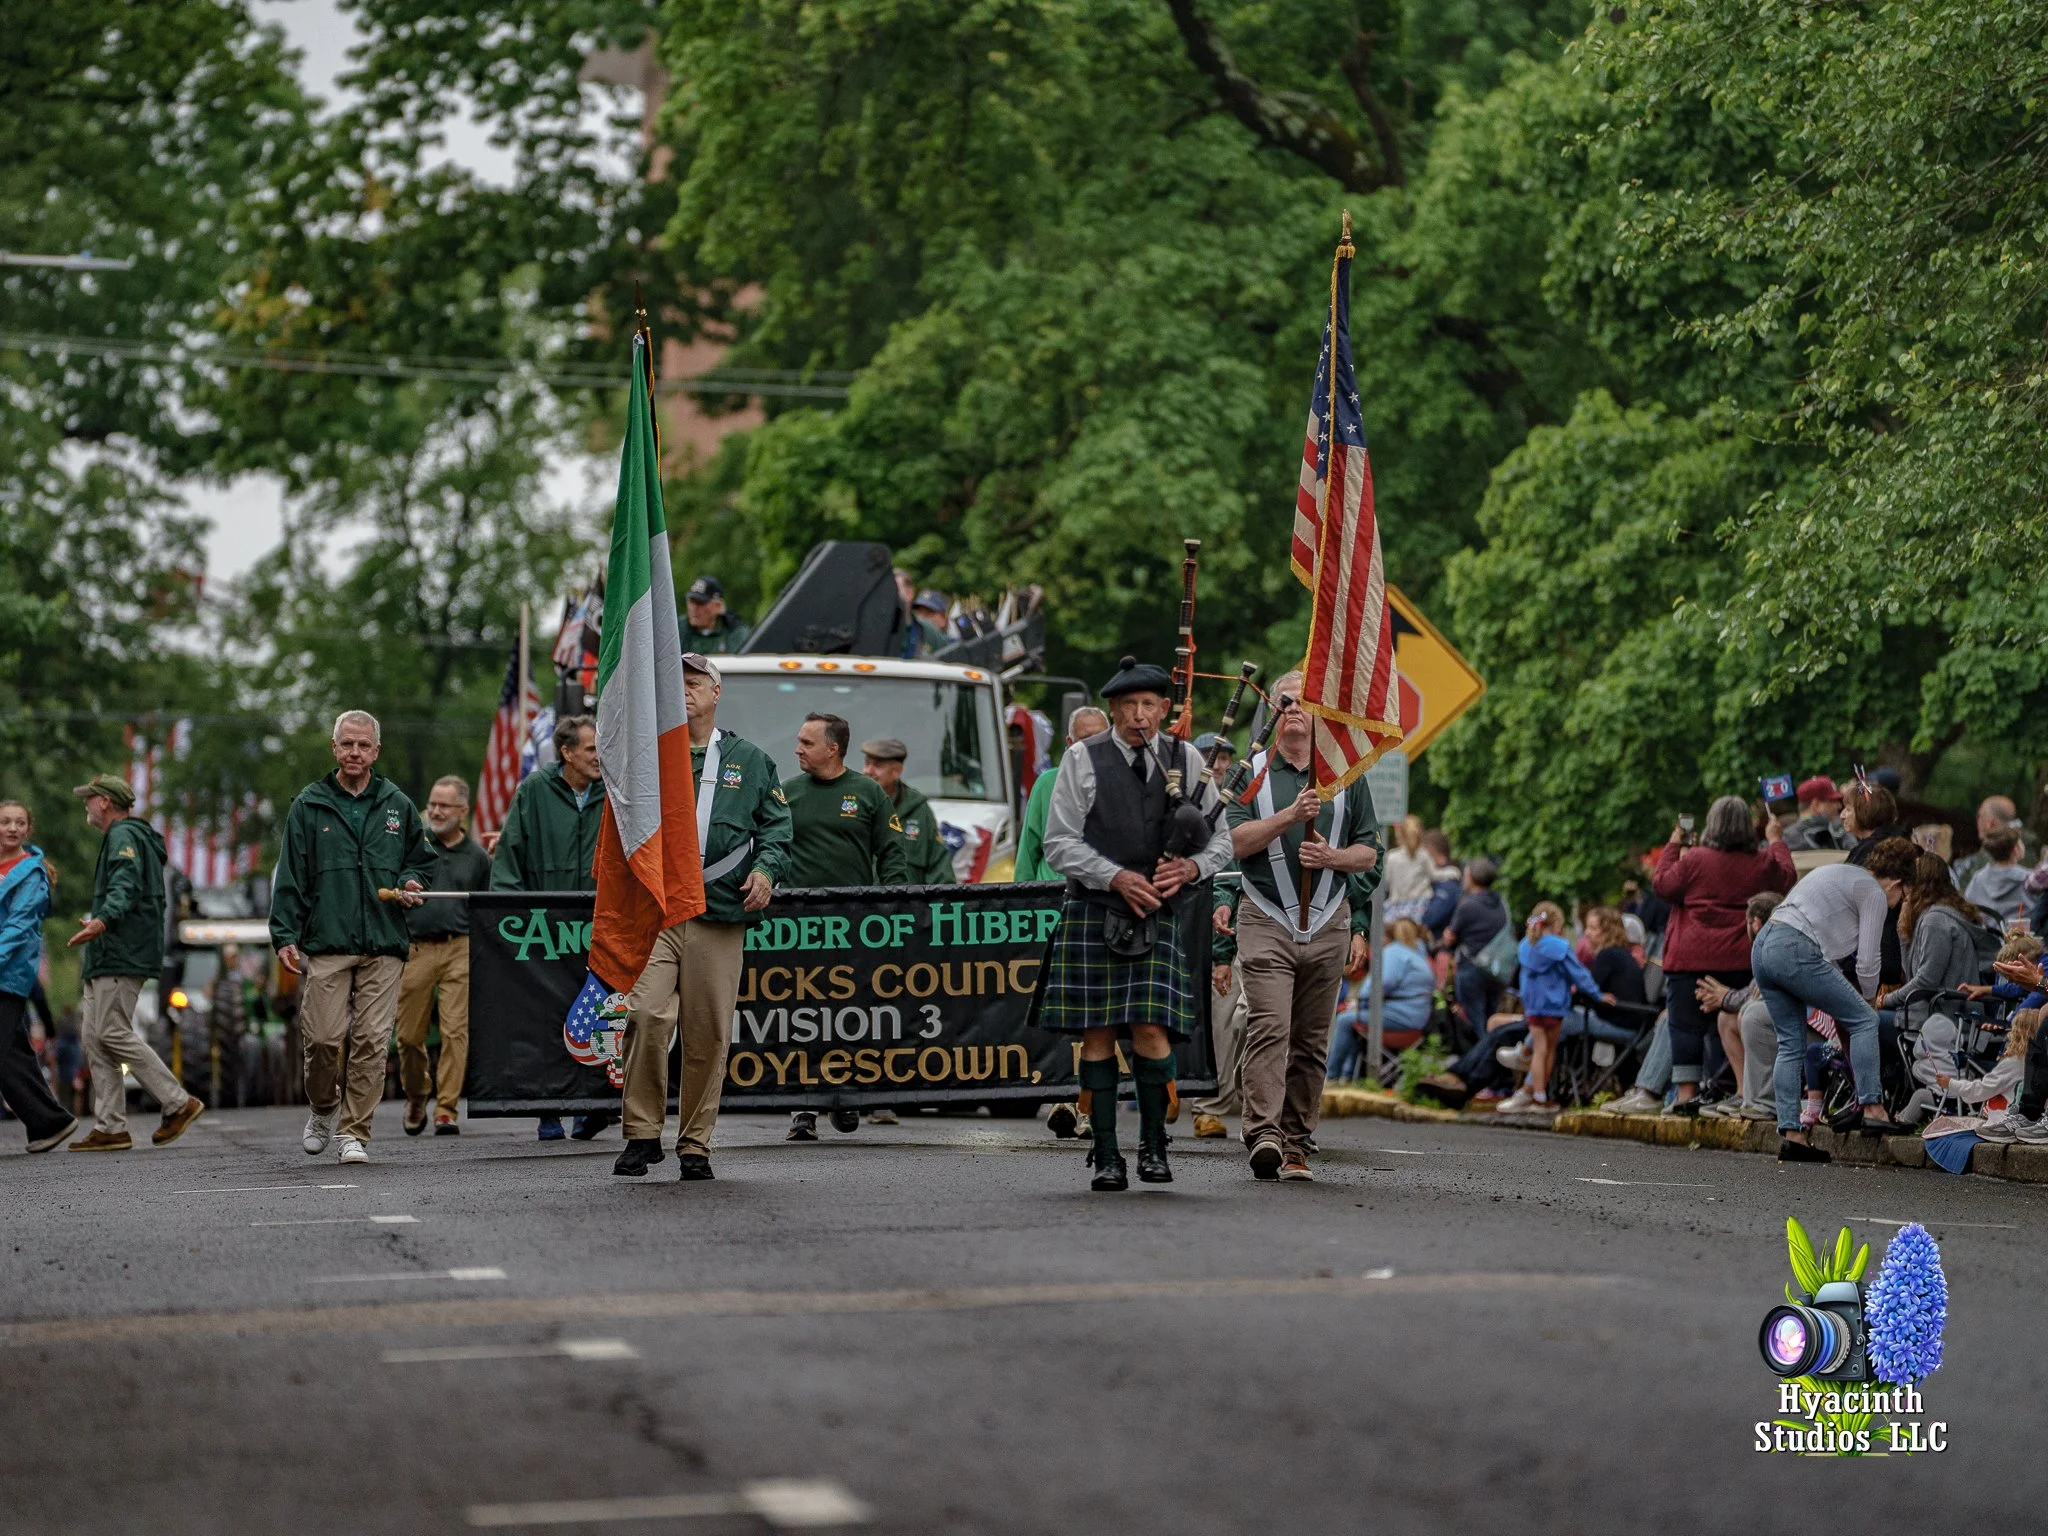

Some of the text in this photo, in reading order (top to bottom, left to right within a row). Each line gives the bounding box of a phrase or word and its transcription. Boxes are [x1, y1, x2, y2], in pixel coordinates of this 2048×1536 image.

[744, 915, 852, 951] RDER
[928, 902, 1062, 947] HIBER
[737, 959, 1041, 1003] UCKS COUNT
[732, 1004, 943, 1044] IVISION 3
[723, 1044, 1043, 1088] OYLESTOWN,
